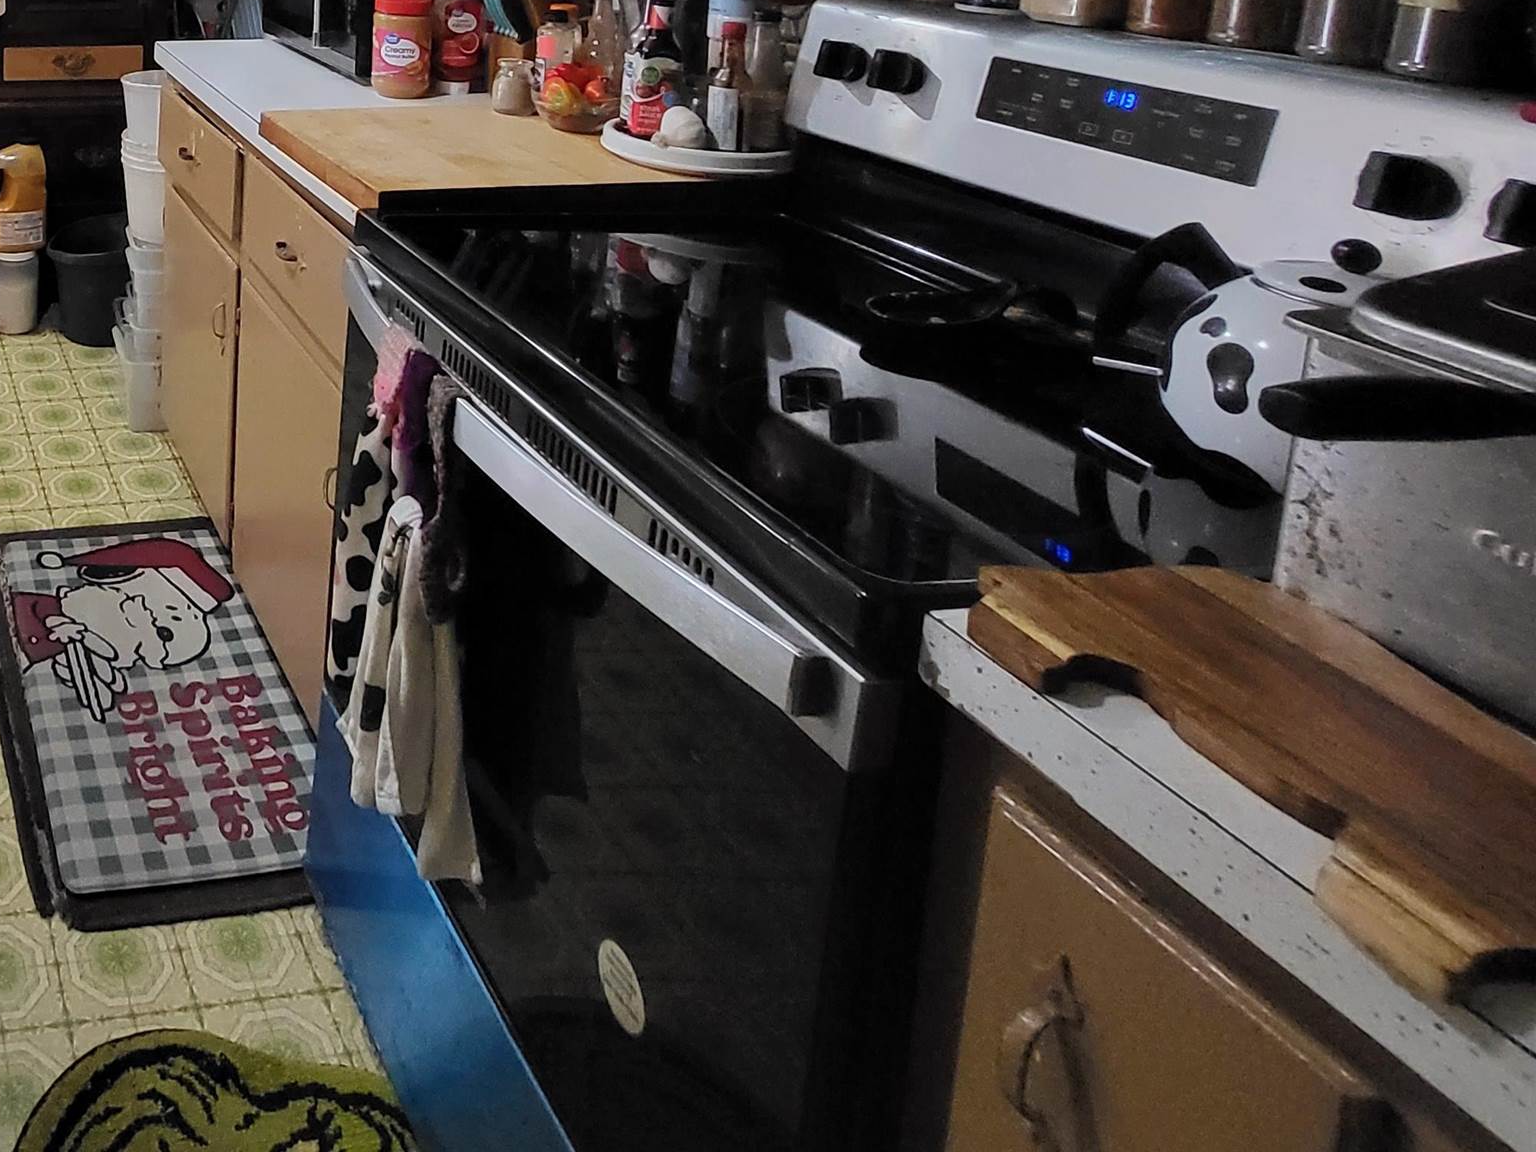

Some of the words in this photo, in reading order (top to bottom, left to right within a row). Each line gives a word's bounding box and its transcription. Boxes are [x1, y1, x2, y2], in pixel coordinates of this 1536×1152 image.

[384, 45, 417, 56] Creamy
[117, 690, 191, 845] Bright
[164, 680, 254, 842] Spirits
[216, 673, 310, 834] Baking
